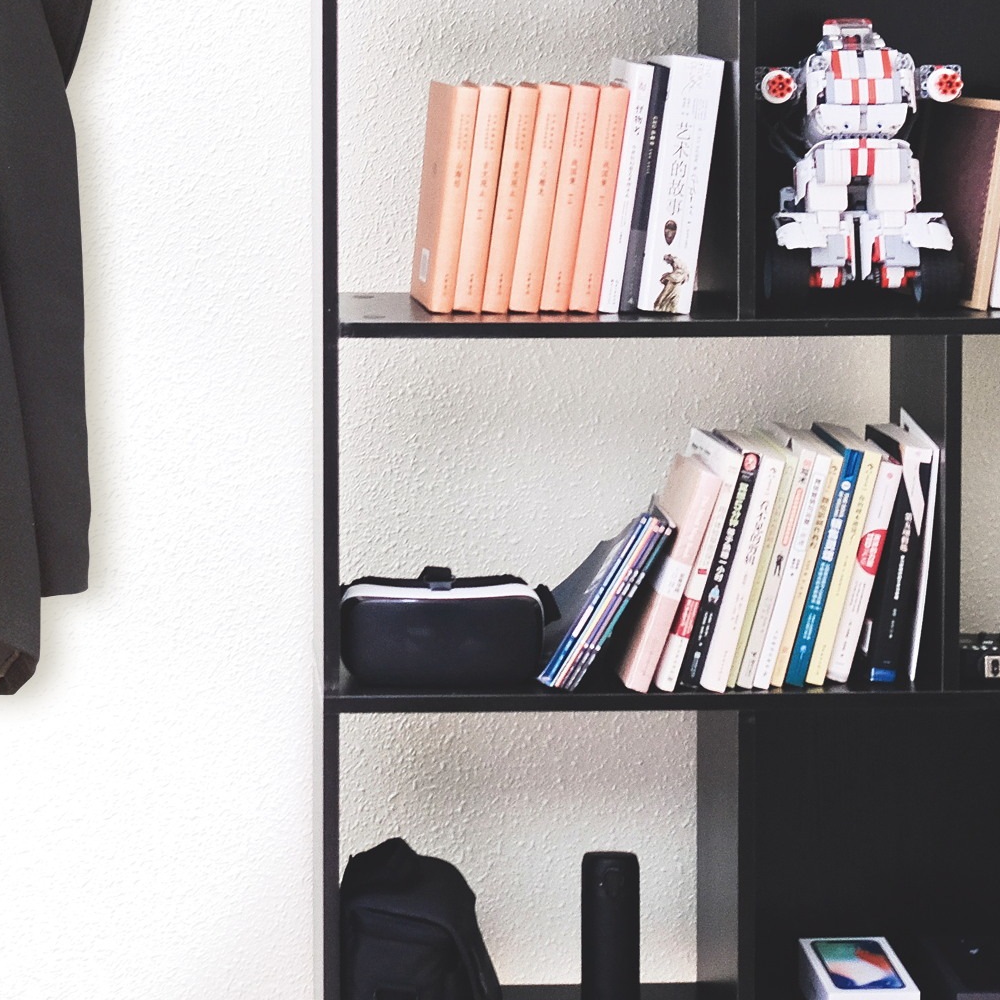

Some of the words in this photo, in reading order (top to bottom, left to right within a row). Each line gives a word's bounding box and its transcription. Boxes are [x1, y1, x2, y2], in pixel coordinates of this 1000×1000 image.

[669, 121, 691, 216] 艺术的故事
